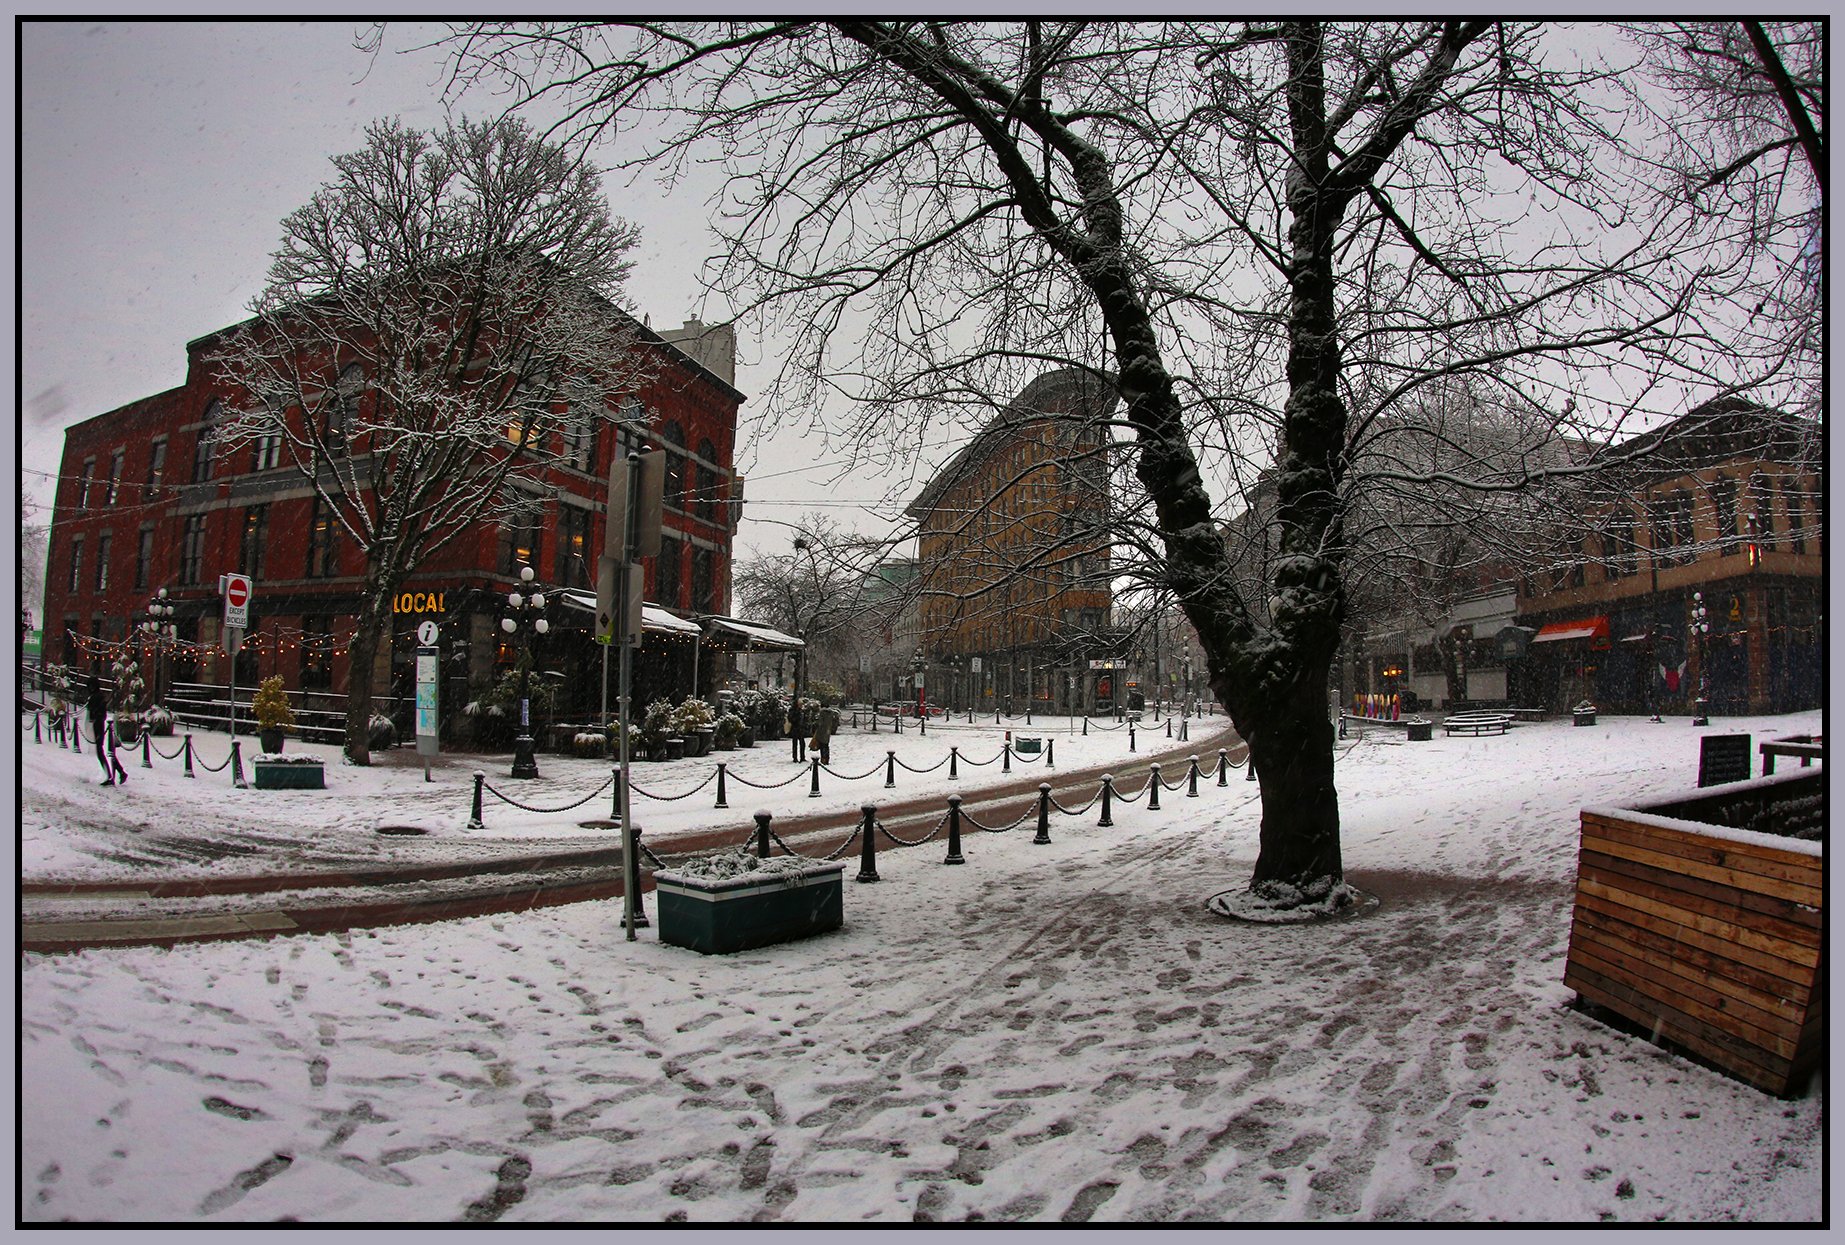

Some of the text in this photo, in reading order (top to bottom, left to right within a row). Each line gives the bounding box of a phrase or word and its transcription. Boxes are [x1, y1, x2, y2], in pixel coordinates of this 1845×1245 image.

[393, 592, 446, 613] LOCAL
[229, 606, 245, 616] EXCEPT
[226, 616, 247, 625] BICYCLES
